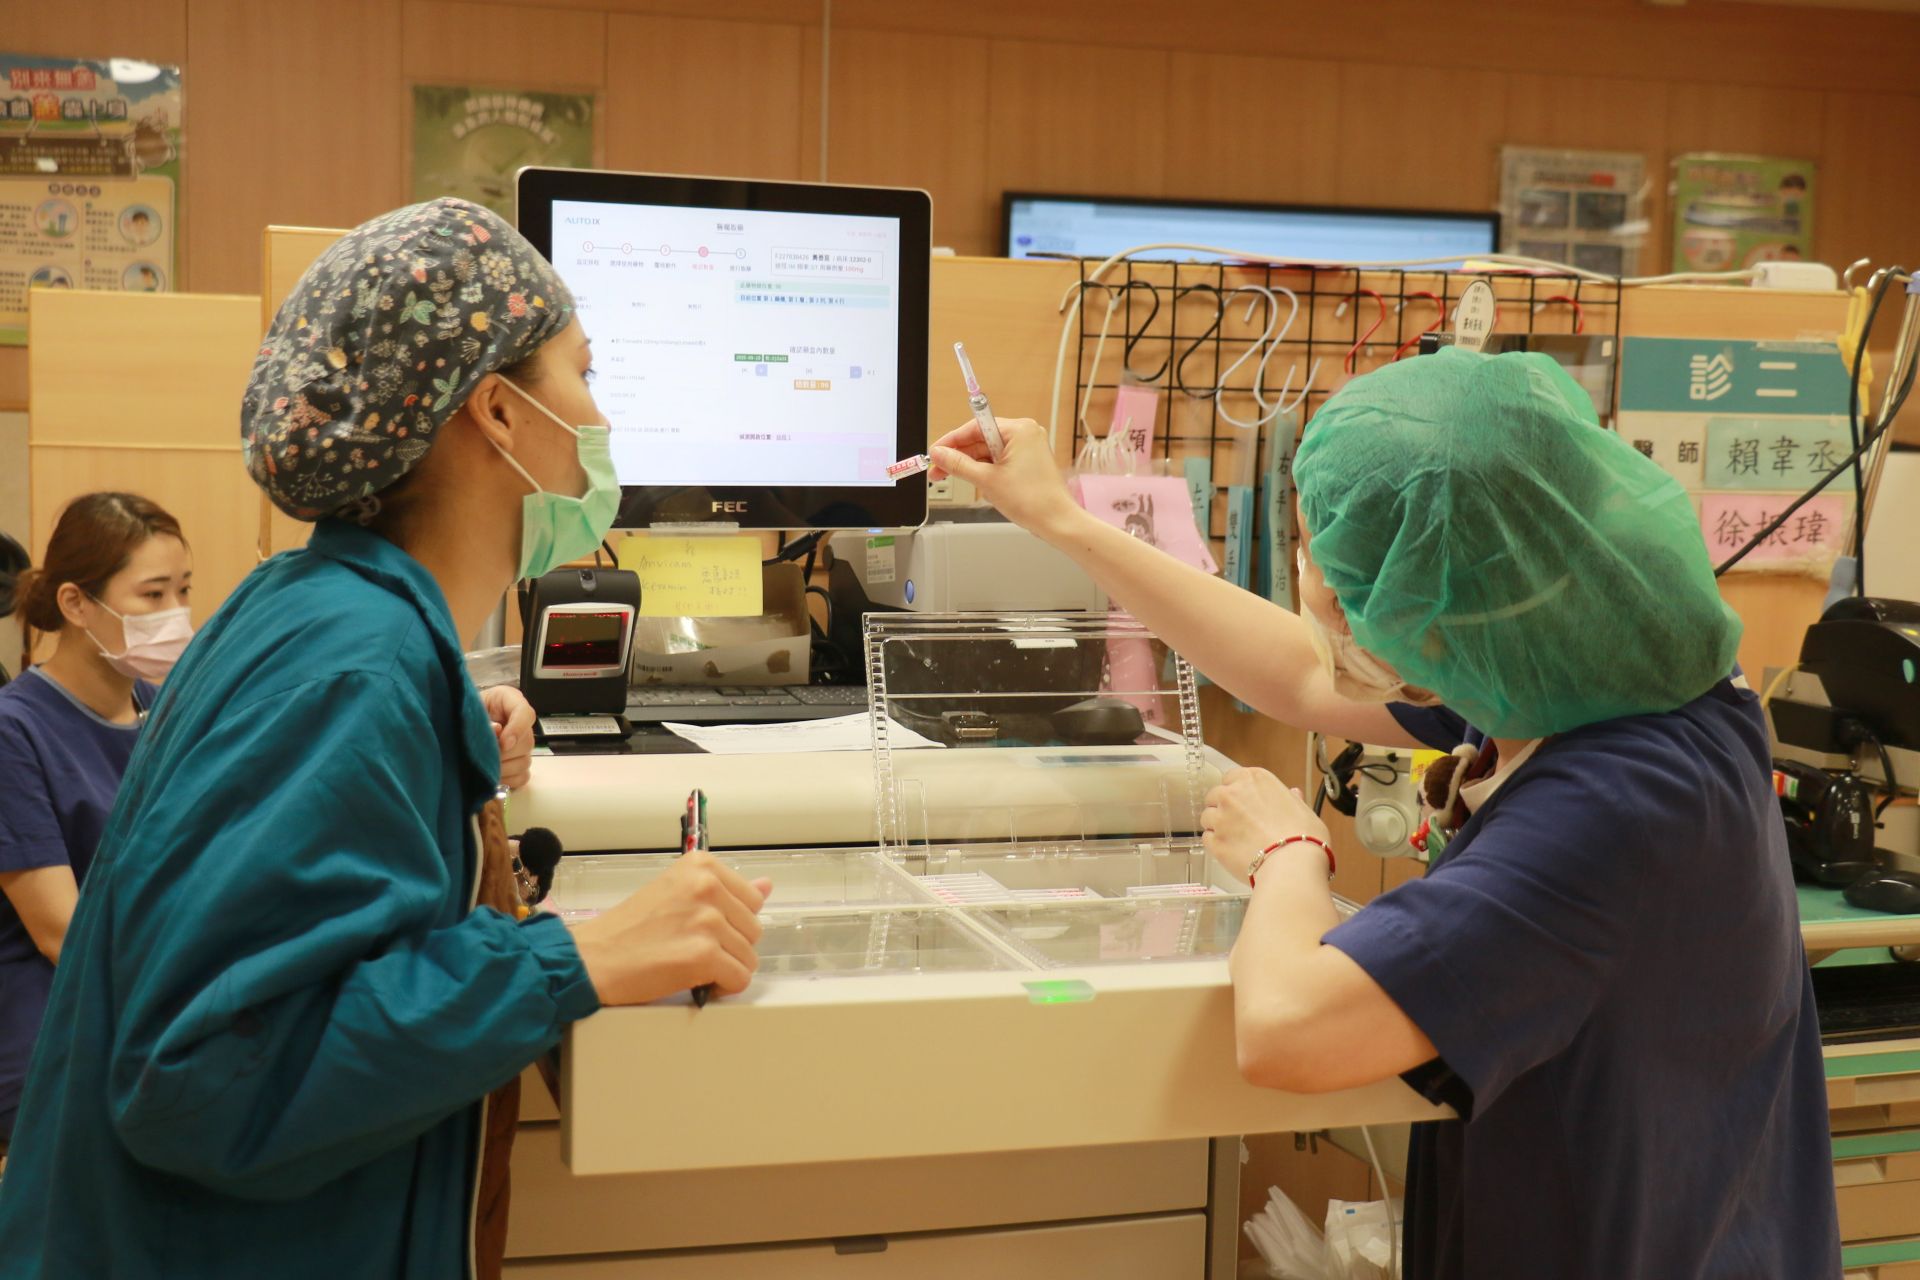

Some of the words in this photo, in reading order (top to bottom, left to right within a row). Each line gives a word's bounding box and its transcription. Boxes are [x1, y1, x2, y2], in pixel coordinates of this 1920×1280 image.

[1725, 435, 1842, 476] 賴韋丞
[711, 501, 748, 513] FEC
